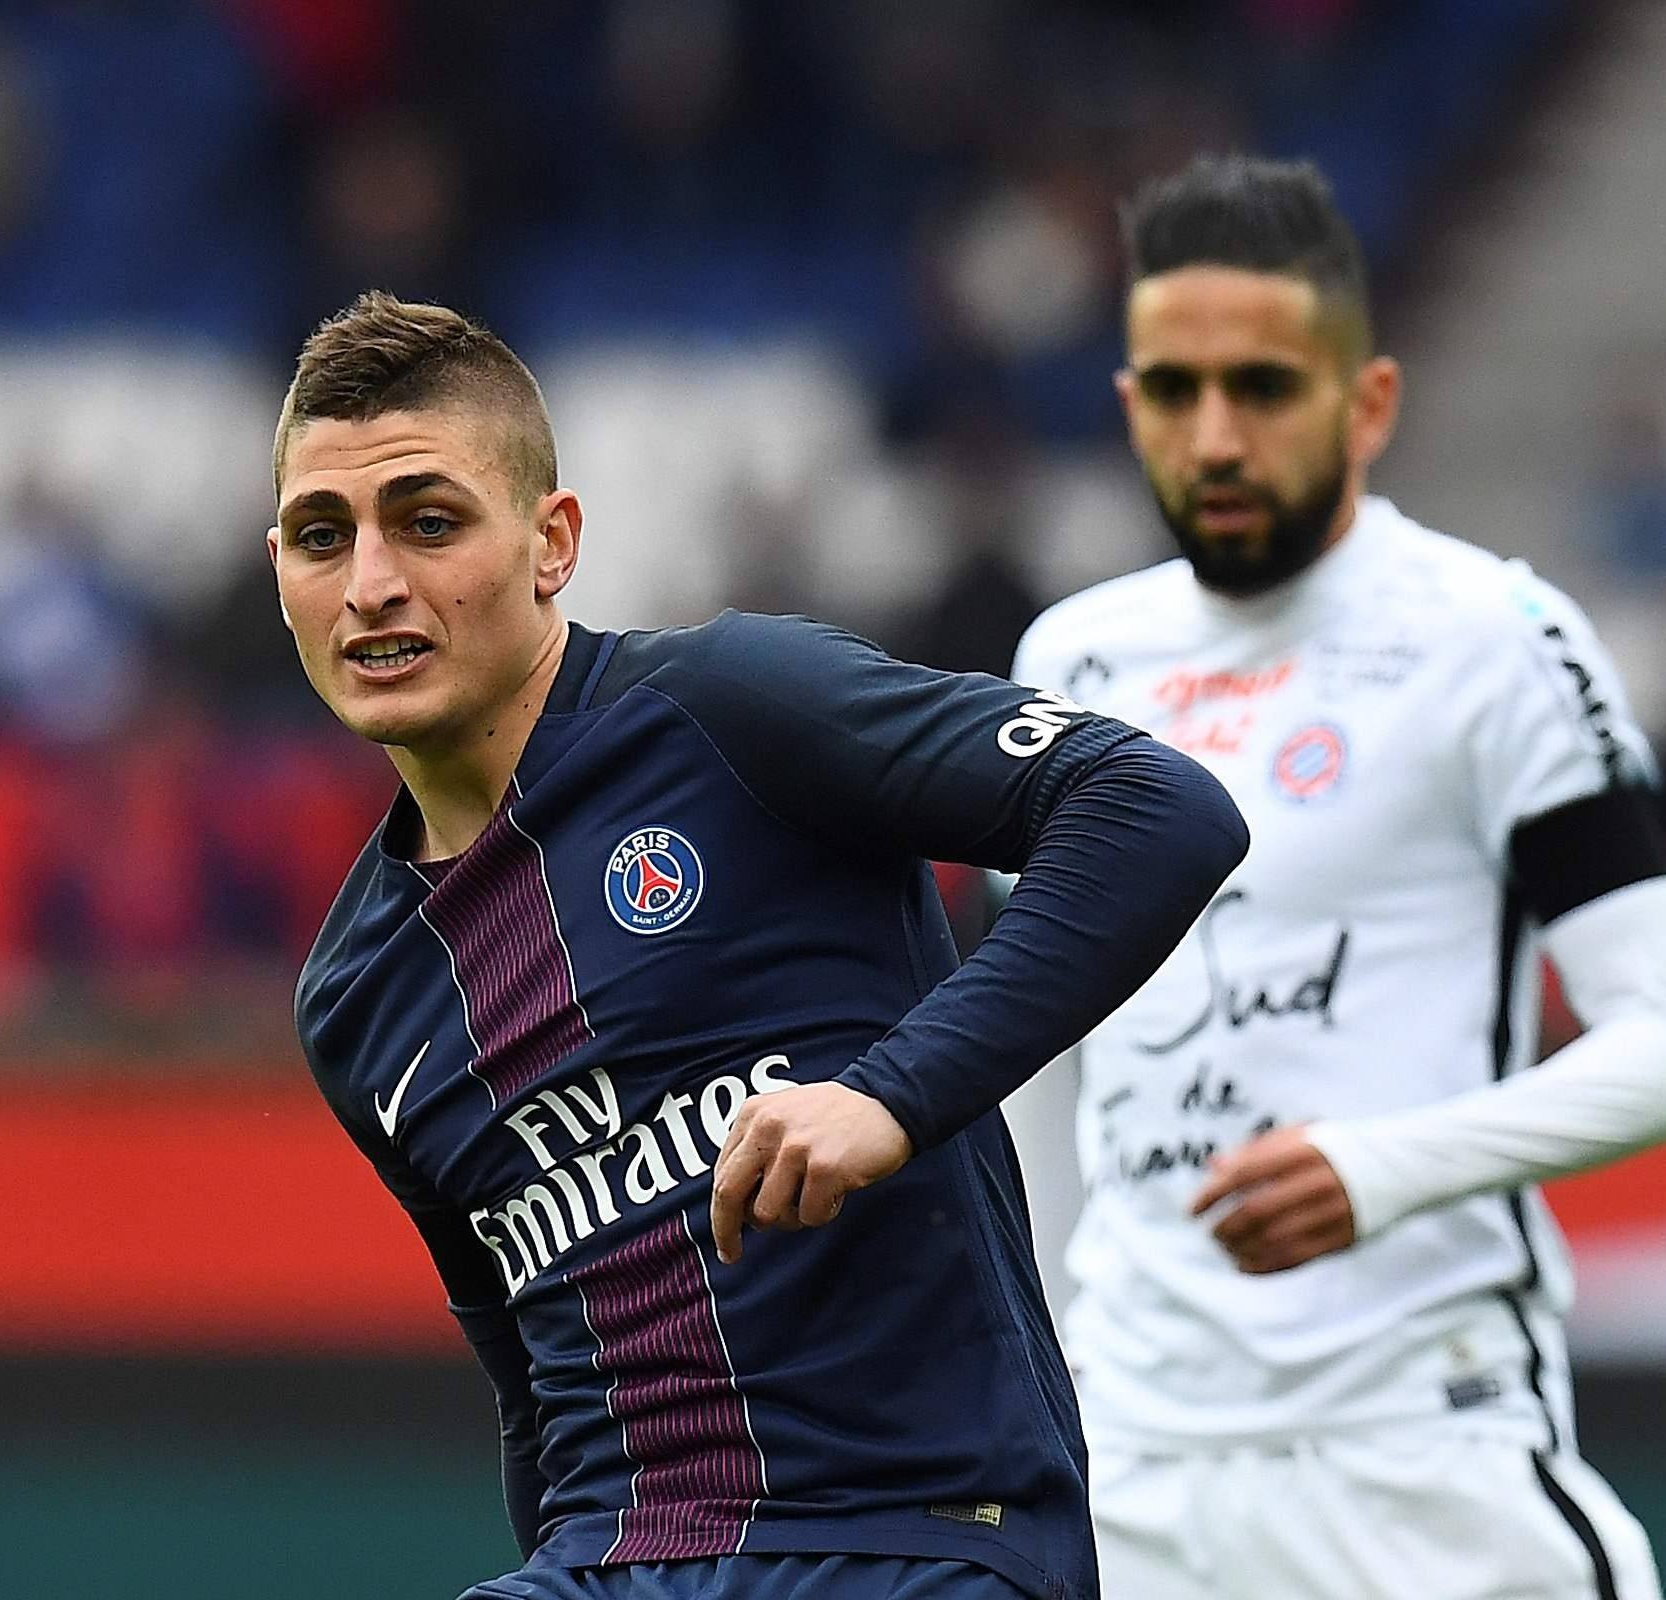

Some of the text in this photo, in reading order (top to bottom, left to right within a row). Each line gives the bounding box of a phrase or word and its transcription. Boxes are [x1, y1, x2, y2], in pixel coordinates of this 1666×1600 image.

[997, 690, 1086, 758] QN
[611, 832, 670, 874] PARIS
[1136, 887, 1348, 1054] Sud
[504, 1067, 622, 1170] Fly
[468, 1055, 800, 1299] Emirates
